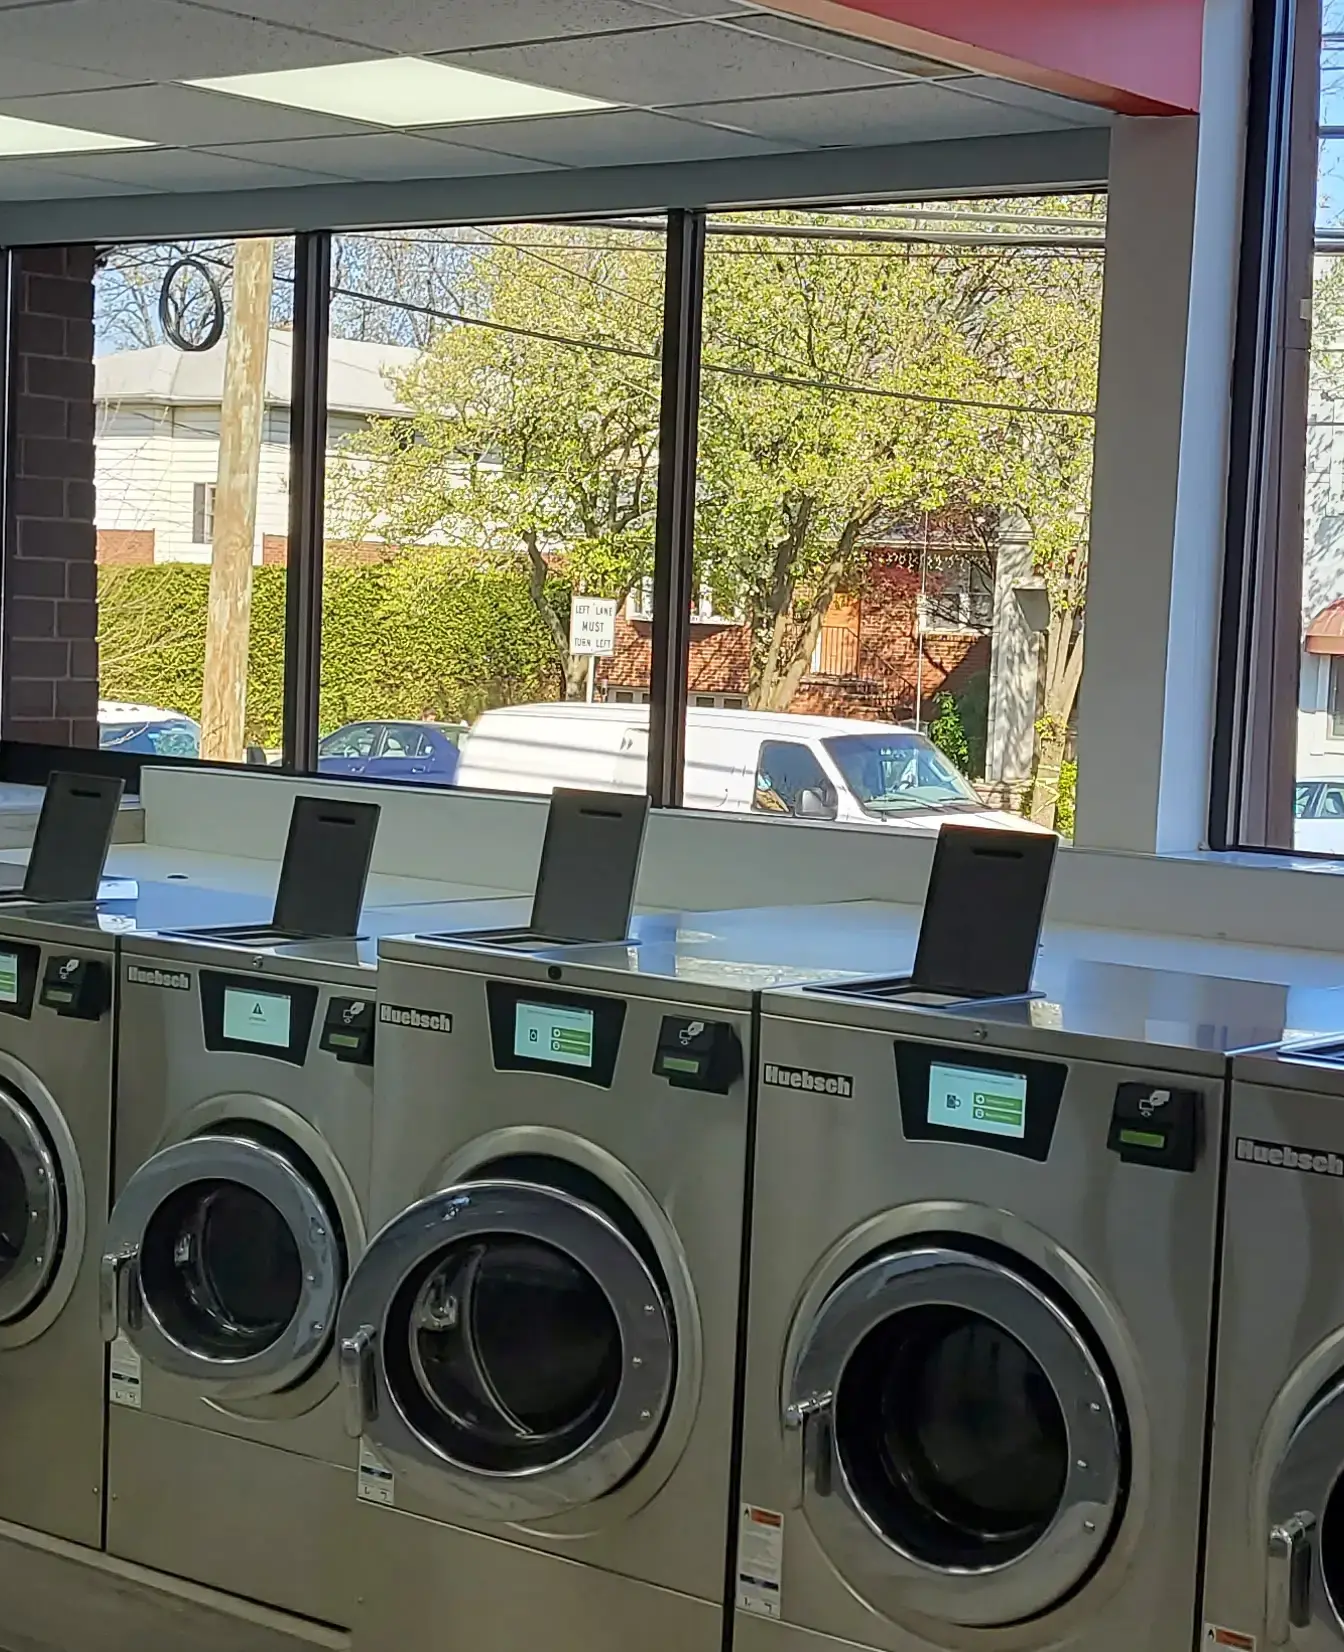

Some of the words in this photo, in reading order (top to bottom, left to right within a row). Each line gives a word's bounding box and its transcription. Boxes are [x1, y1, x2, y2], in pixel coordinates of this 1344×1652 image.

[575, 605, 590, 615] LEFT
[595, 606, 613, 617] LANE
[582, 621, 604, 632] MUST
[596, 639, 611, 648] LEFT
[128, 966, 189, 989] Huebsch
[381, 1004, 451, 1032] Huebsch
[765, 1064, 851, 1096] Huebsch
[1237, 1138, 1344, 1176] Huebsch
